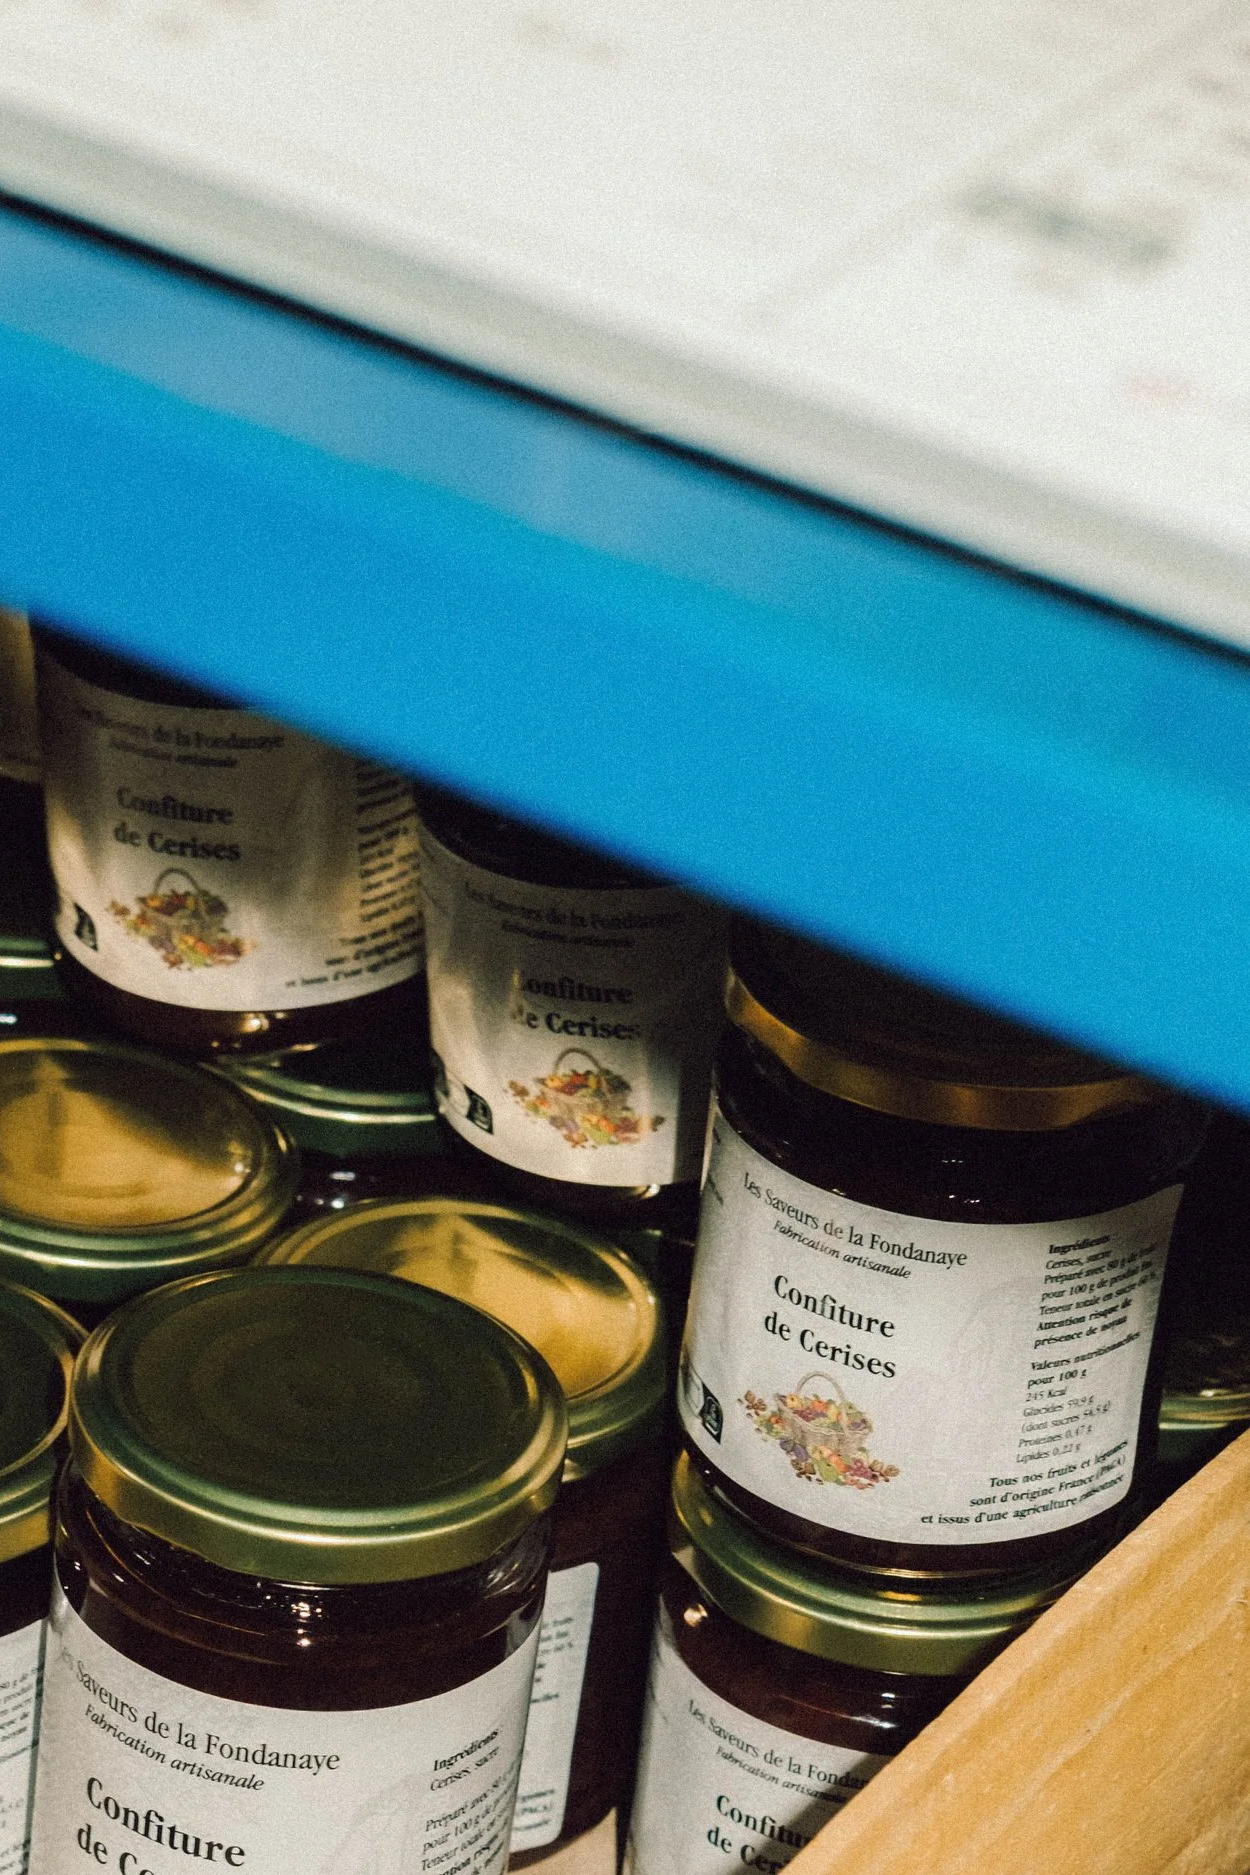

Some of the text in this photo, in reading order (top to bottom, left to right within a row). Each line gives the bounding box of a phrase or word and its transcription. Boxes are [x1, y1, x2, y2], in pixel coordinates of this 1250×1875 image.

[113, 821, 242, 862] de Cerises
[517, 970, 634, 1004] onfiture
[544, 1010, 643, 1041] Cerises
[744, 1172, 968, 1270] Les Saveurs de la Fondanaye
[773, 1220, 912, 1280] Fabrication artisanale
[773, 1273, 896, 1340] Confiture
[1041, 1289, 1066, 1303] pour
[1070, 1283, 1088, 1296] 100
[763, 1309, 897, 1379] de Cerises
[1027, 1376, 1055, 1390] pour
[1059, 1369, 1079, 1382] 100
[1030, 1359, 1071, 1371] Valeurs
[969, 1494, 997, 1508] sont
[1000, 1486, 1055, 1504] d'origine
[1058, 1474, 1095, 1494] France
[989, 1476, 1018, 1489] Tous
[1022, 1472, 1044, 1484] nos
[1047, 1463, 1078, 1481] fruits
[1081, 1458, 1091, 1469] et
[921, 1514, 934, 1524] et
[938, 1512, 970, 1525] issus
[974, 1510, 1009, 1524] d'une
[1012, 1495, 1078, 1520] agriculture
[76, 1660, 341, 1776] Saveurs de la Fondanaye
[688, 1699, 706, 1725] Les
[708, 1717, 759, 1758] Saveurs
[763, 1749, 784, 1768] de
[788, 1756, 802, 1775] la
[85, 1704, 167, 1765] Fabrication
[170, 1756, 266, 1792] artisanale
[715, 1746, 780, 1784] Fabrication
[86, 1775, 246, 1868] Confiture
[422, 1832, 451, 1856] pour
[454, 1817, 474, 1837] 100
[707, 1826, 732, 1853] de
[76, 1822, 109, 1866] de
